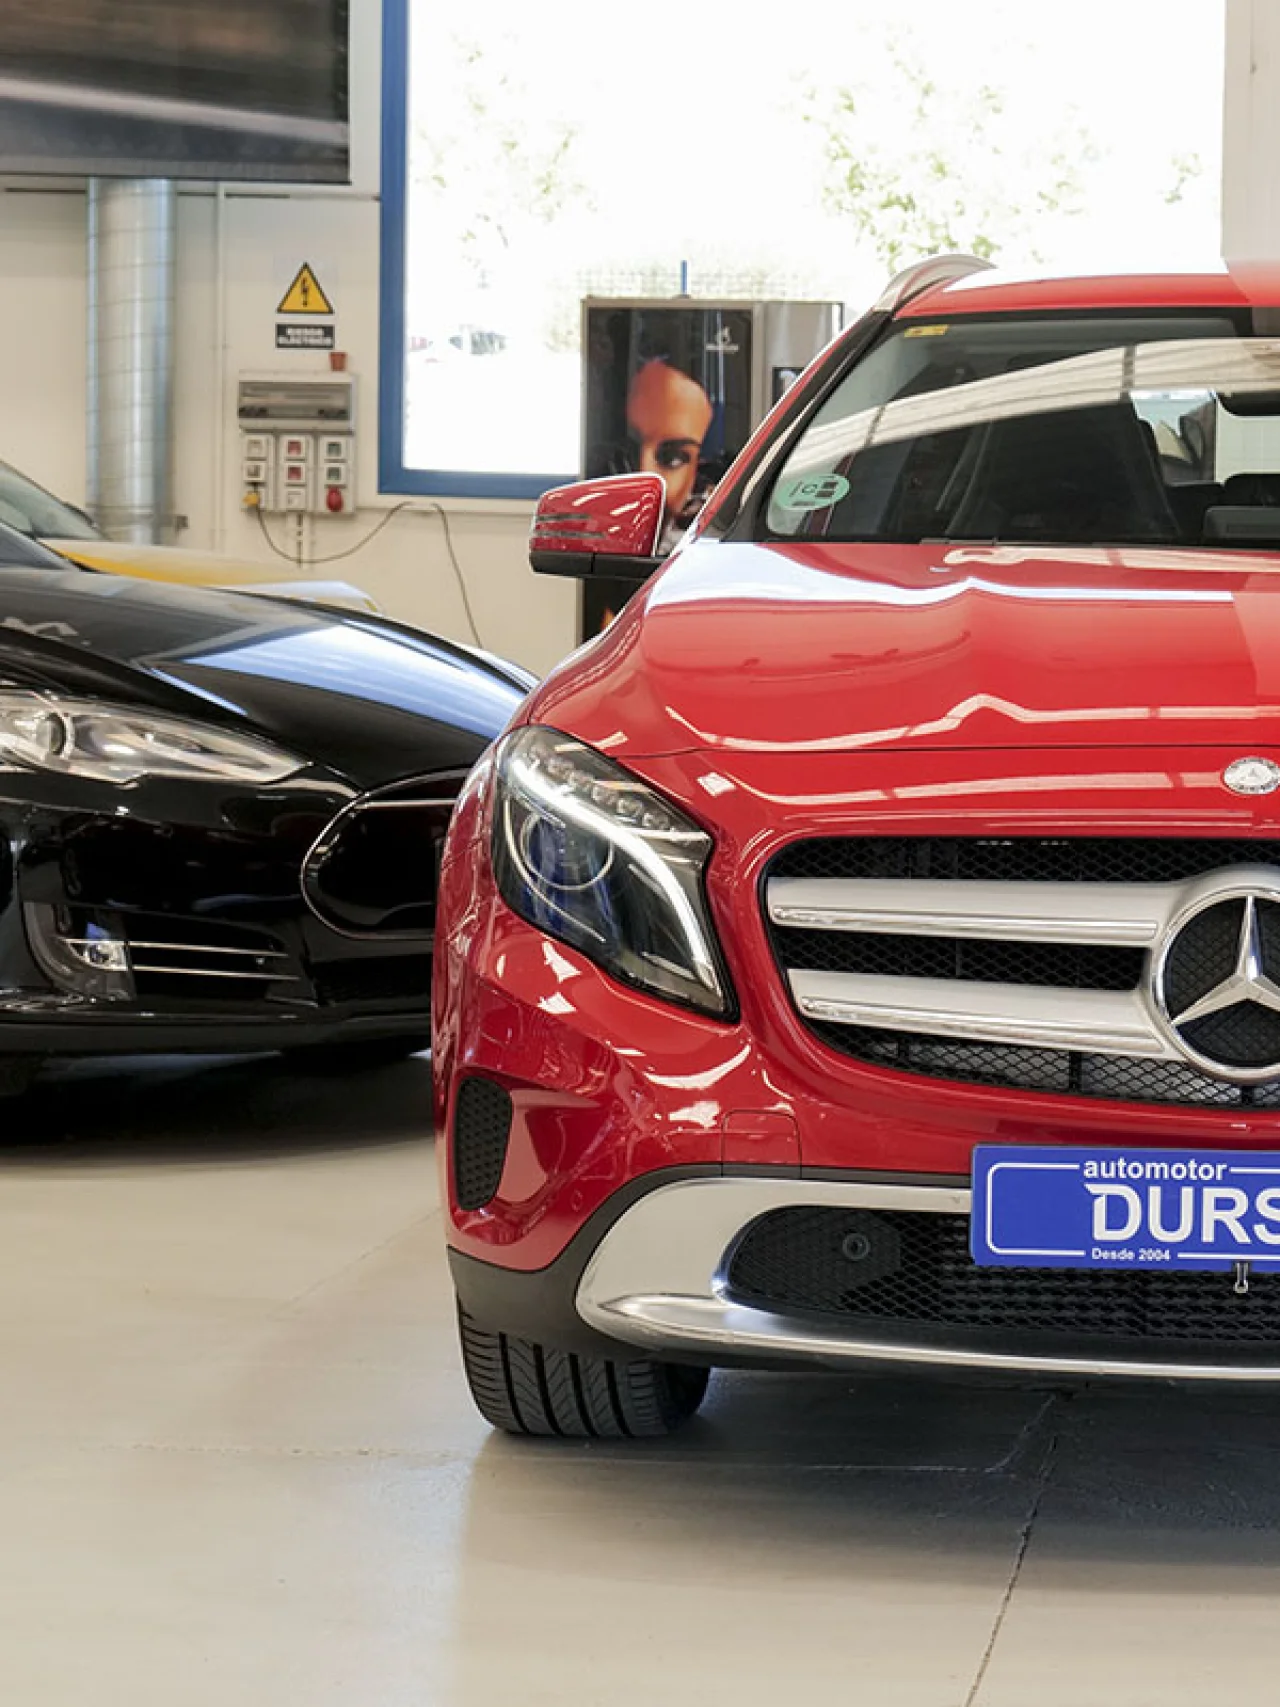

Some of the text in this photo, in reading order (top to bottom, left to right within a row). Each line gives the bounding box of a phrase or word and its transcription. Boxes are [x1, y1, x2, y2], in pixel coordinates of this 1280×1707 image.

[1083, 1157, 1228, 1181] automotor
[1091, 1247, 1172, 1261] Desde 2004
